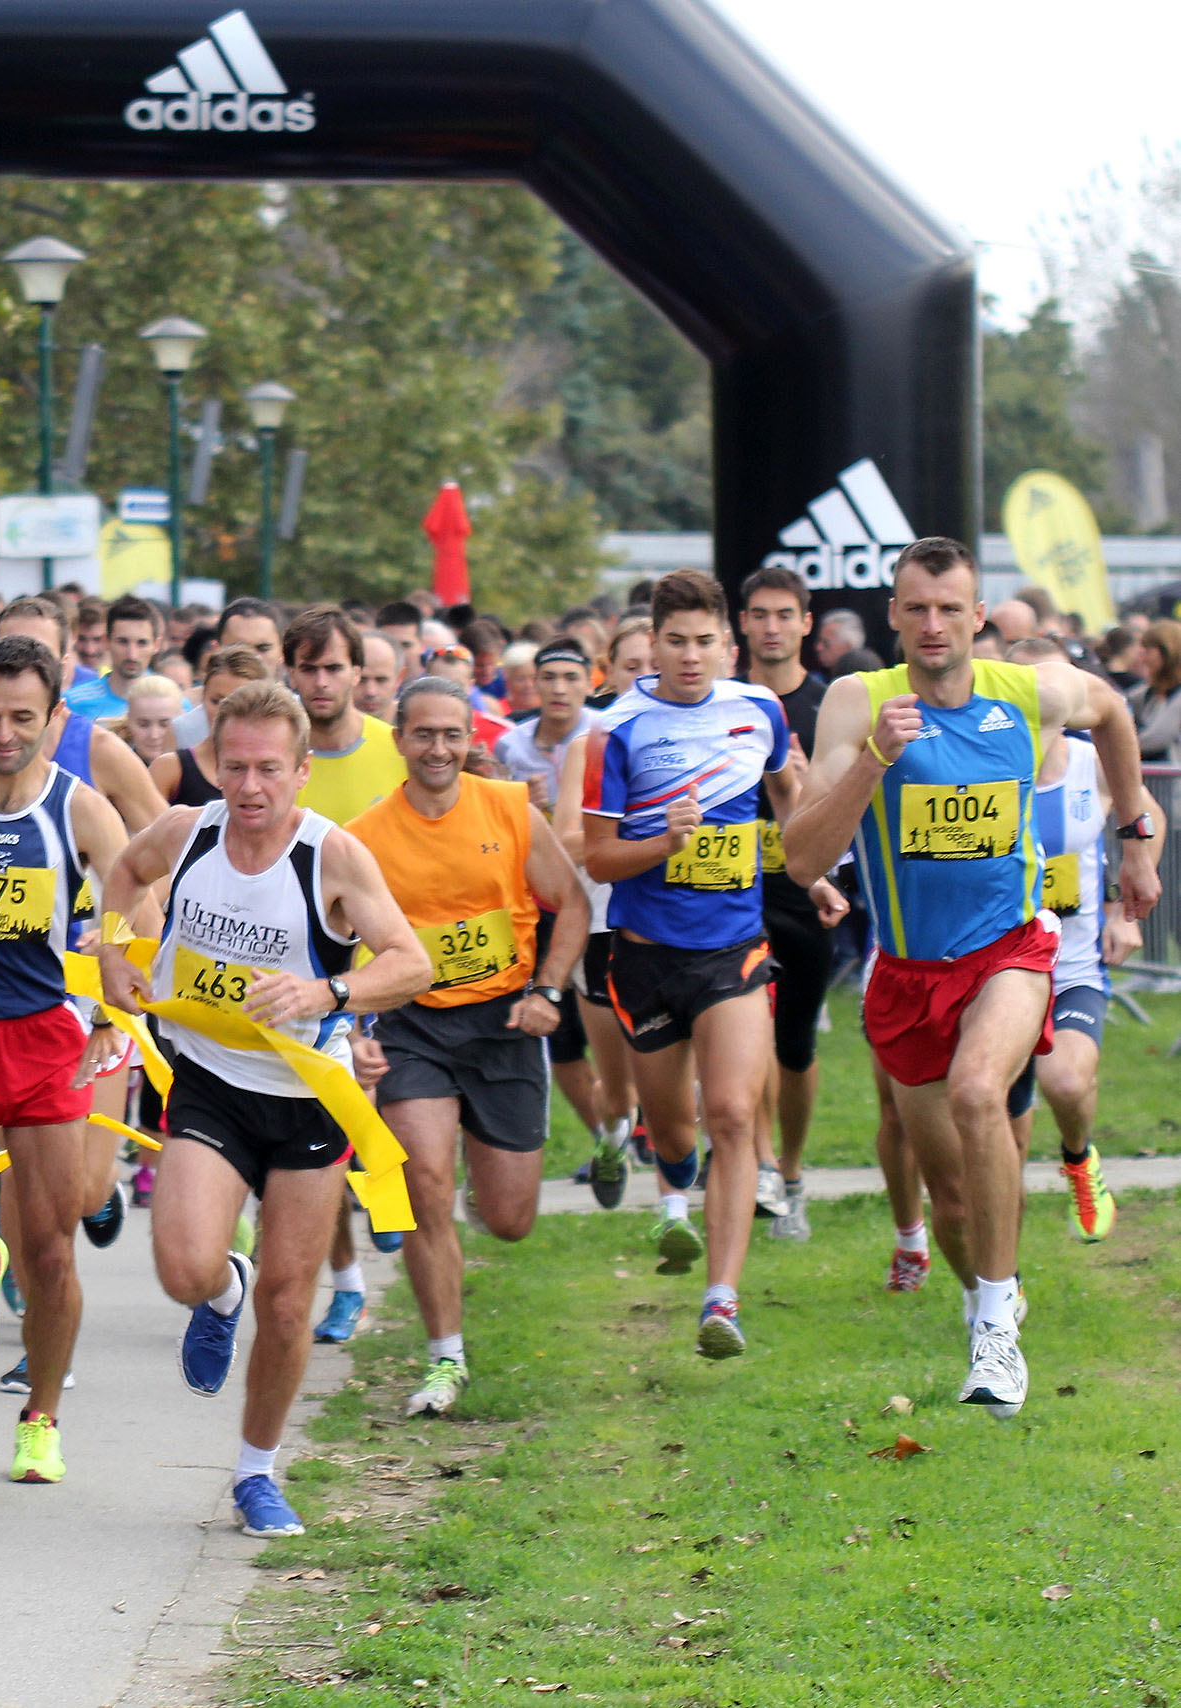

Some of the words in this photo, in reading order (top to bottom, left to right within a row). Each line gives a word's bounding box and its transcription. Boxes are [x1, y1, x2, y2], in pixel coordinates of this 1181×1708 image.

[124, 91, 316, 133] adidas
[925, 795, 999, 823] 1004
[697, 835, 740, 859] 878
[180, 919, 289, 957] NUTRITION
[182, 898, 289, 945] ULTIMATE
[440, 925, 488, 956] 326
[194, 968, 247, 1003] 463
